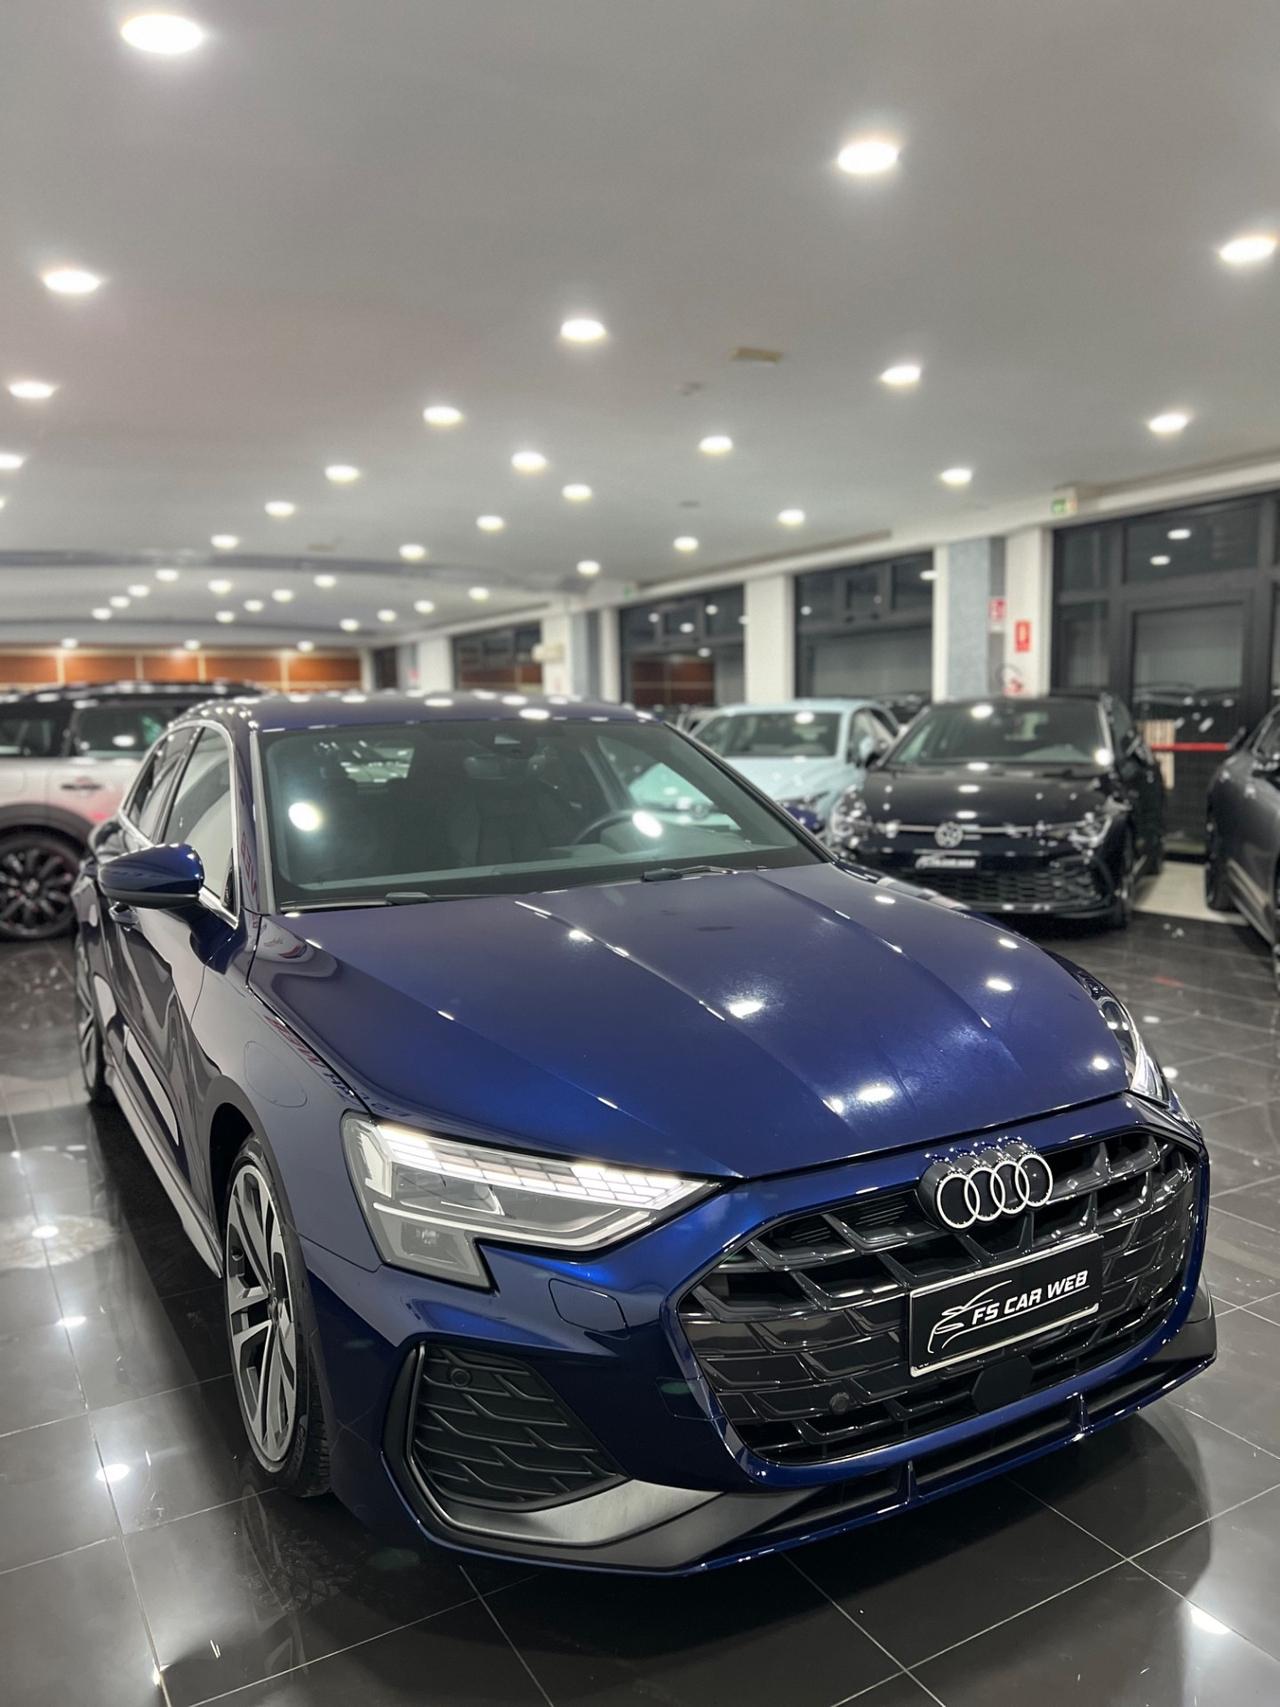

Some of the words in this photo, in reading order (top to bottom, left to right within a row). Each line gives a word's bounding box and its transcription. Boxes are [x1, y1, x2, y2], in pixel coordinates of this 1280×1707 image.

[972, 1302, 1000, 1325] FS
[1004, 1288, 1042, 1314] CAR
[1047, 1270, 1088, 1298] WEB
